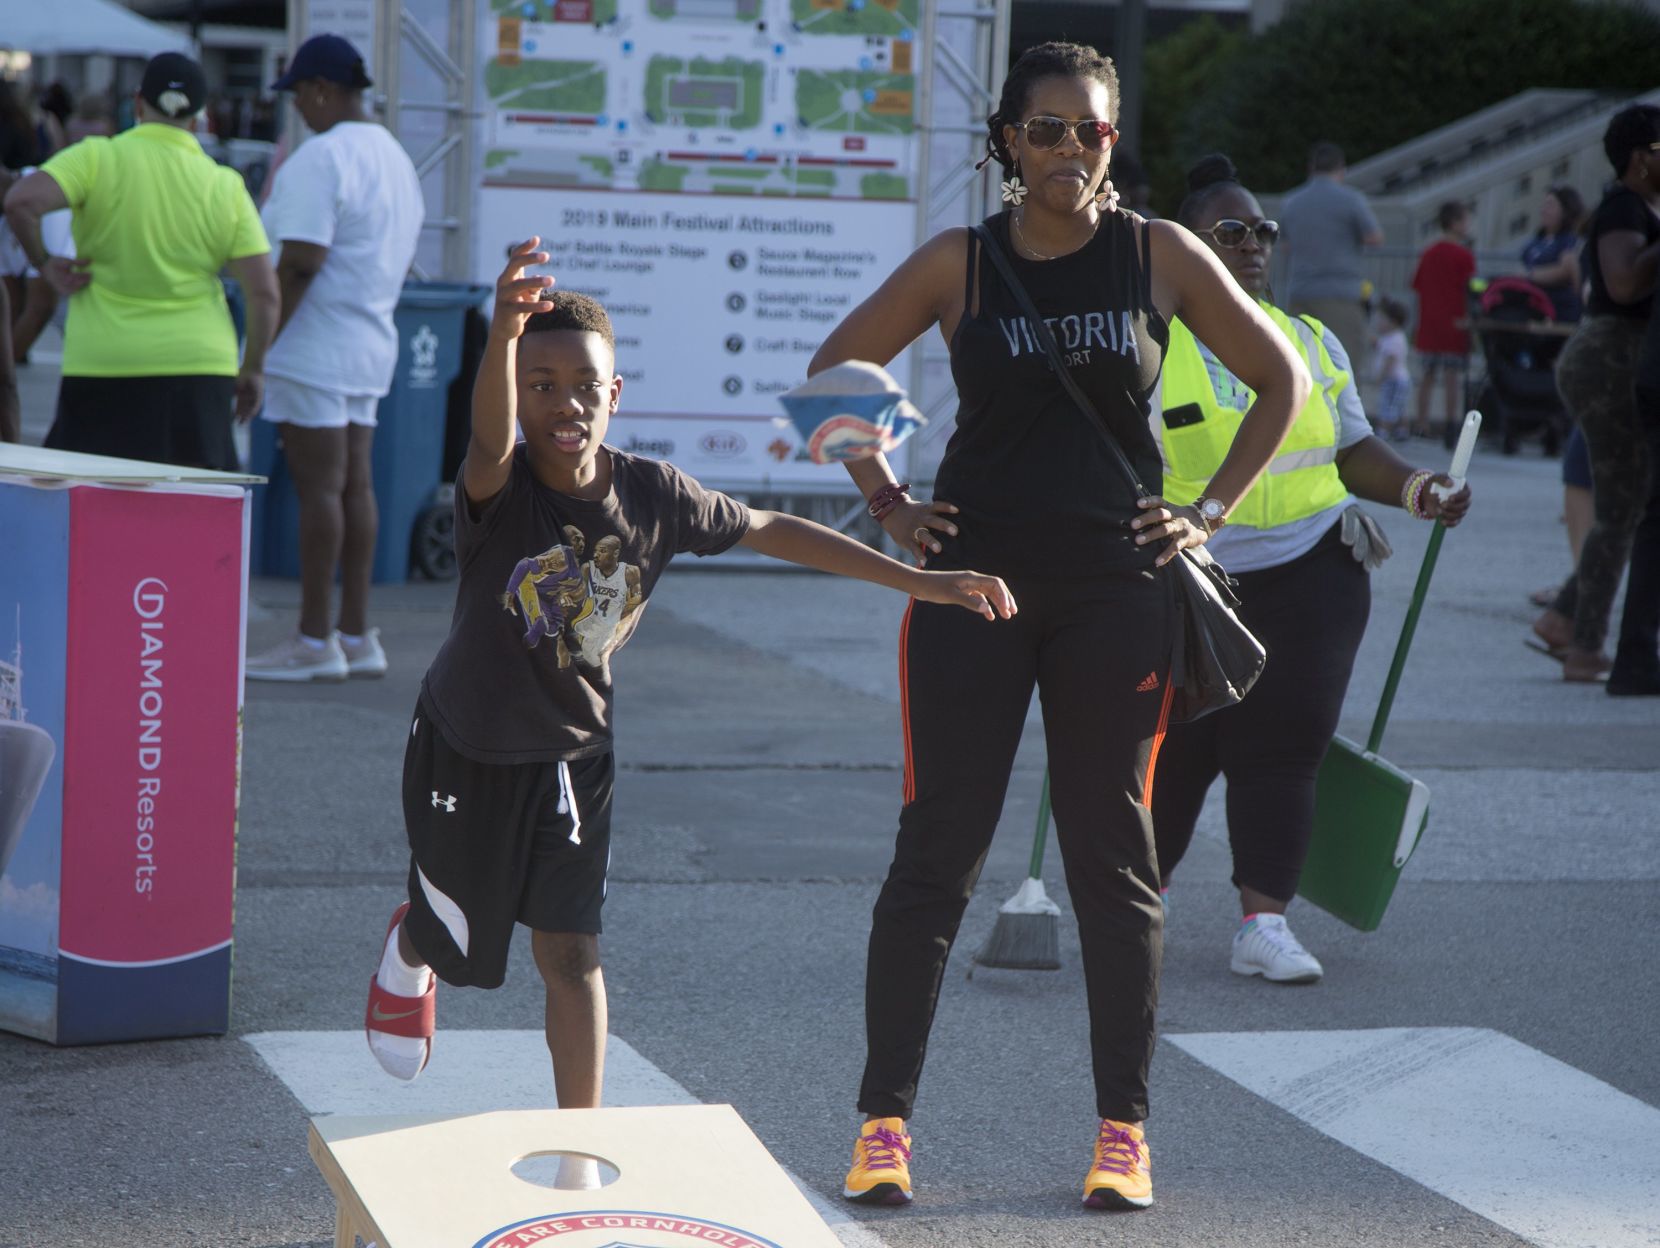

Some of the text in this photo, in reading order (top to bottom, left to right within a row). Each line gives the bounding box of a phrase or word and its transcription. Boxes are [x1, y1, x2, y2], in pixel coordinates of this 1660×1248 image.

[562, 210, 835, 235] 2019 Main Festival Attractions
[669, 243, 708, 259] Stage
[624, 436, 675, 455] Jeep
[133, 577, 168, 893] DIAMOND Resorts
[516, 1221, 573, 1243] ARE
